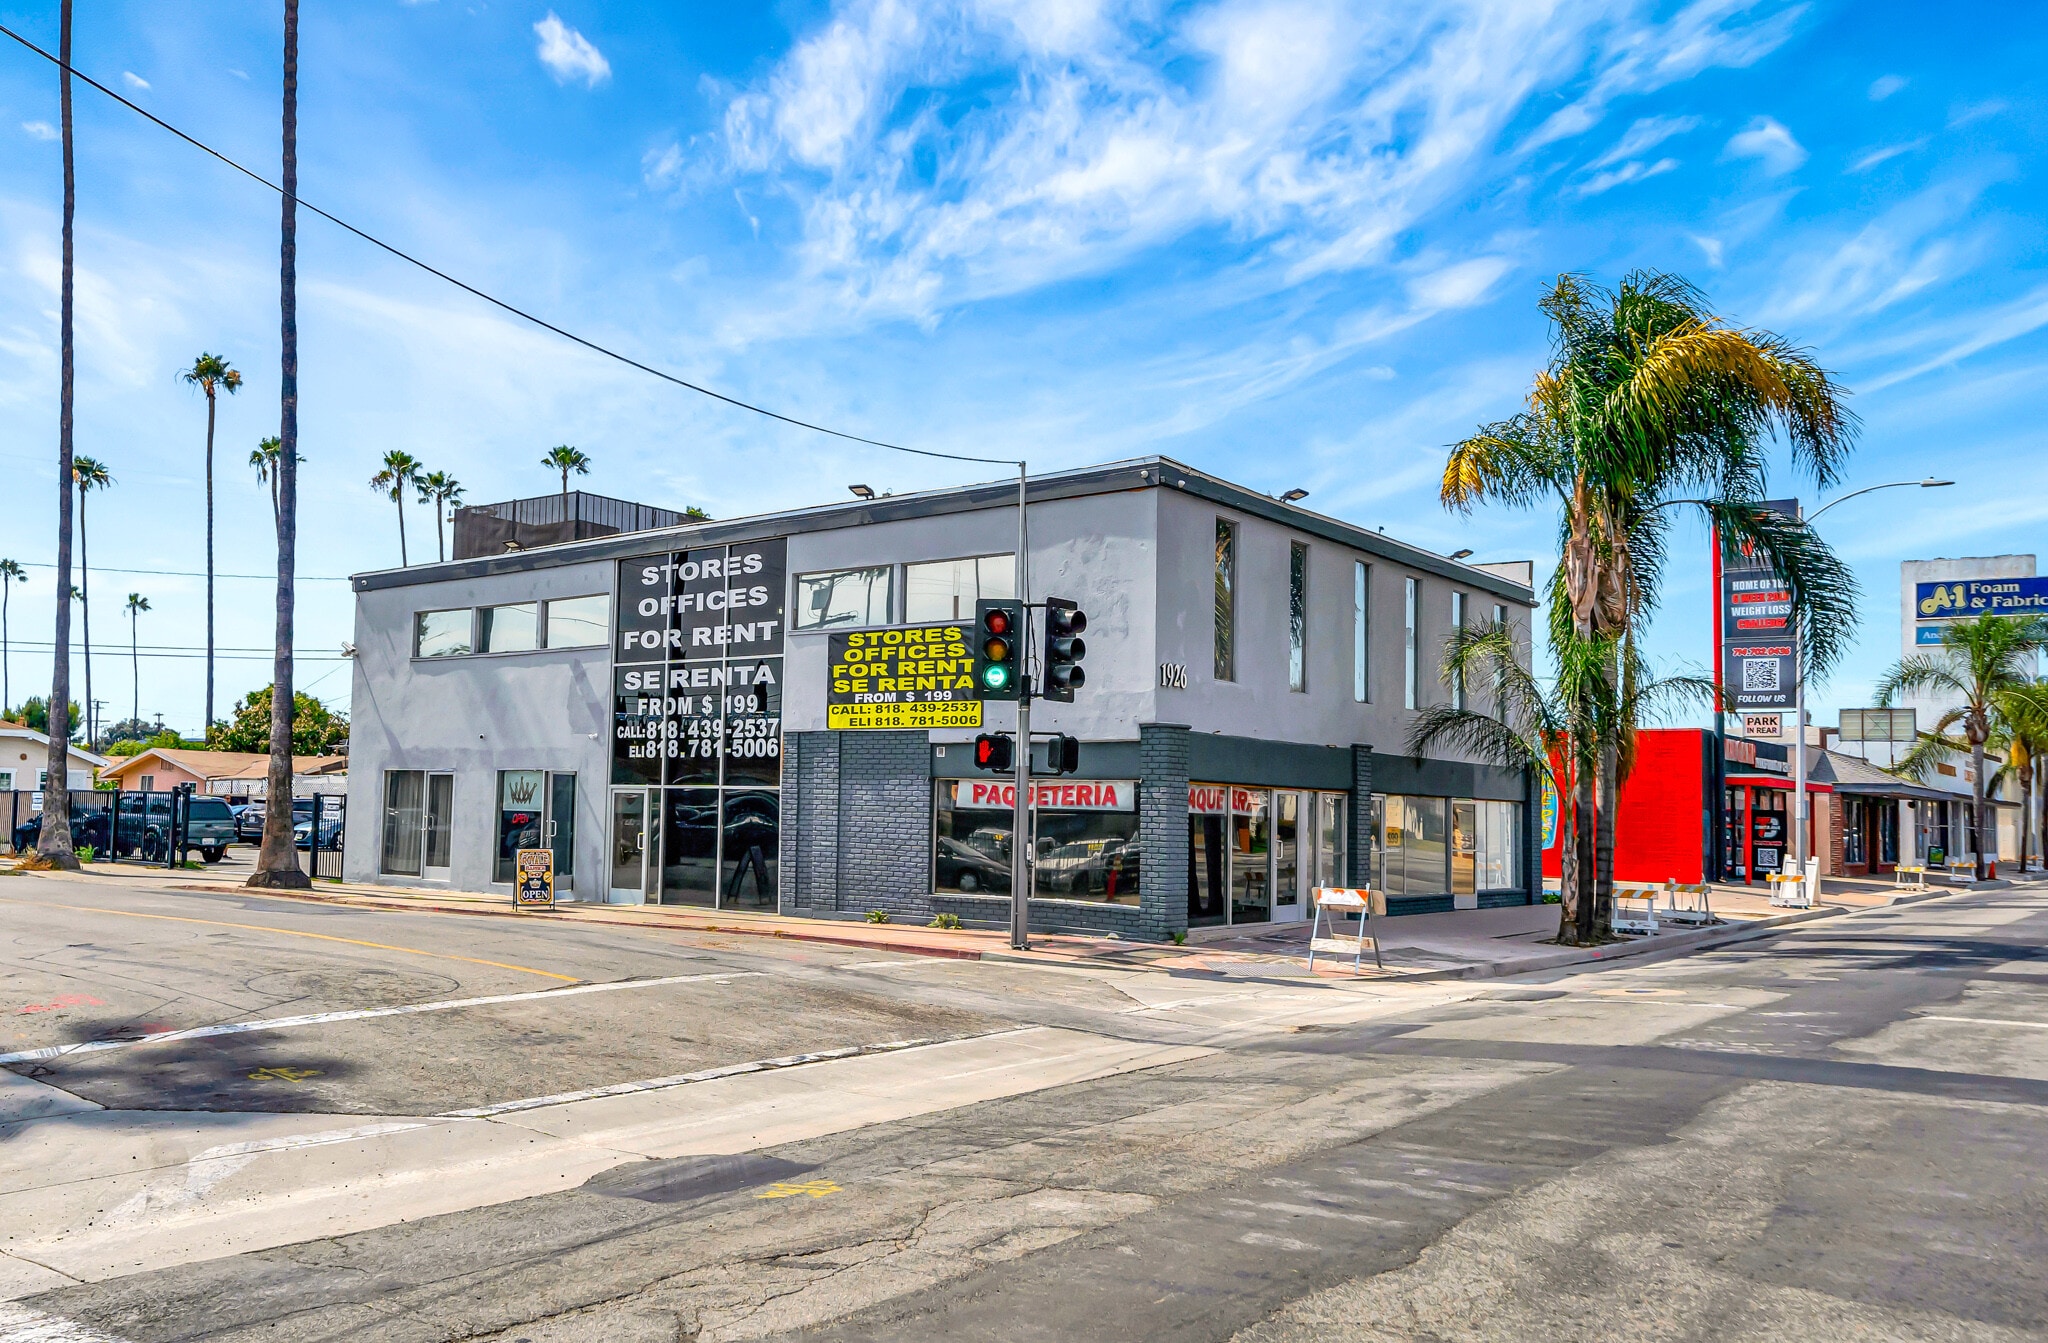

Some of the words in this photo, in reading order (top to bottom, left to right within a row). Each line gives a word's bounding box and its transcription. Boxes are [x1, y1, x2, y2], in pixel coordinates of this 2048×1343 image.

[642, 554, 763, 586] STORES
[1732, 580, 1758, 591] HOME
[1970, 583, 2020, 594] Foam
[638, 586, 768, 616] OFFICES
[1970, 597, 1986, 608] &
[1992, 594, 2048, 607] Fabric
[1731, 606, 1766, 616] WEIGHT
[1768, 605, 1791, 614] LOSS
[624, 629, 682, 650] FOR
[692, 621, 778, 646] RENT
[848, 627, 962, 647] STORES
[844, 643, 965, 662] OFFICES
[833, 663, 888, 678] FOR
[898, 659, 974, 675] RENT
[624, 671, 661, 690] SE
[670, 665, 776, 688] RENTA
[1161, 663, 1187, 689] 1926
[833, 679, 868, 693] SE
[878, 675, 974, 692] RENTA
[855, 693, 896, 703] FROM
[906, 691, 915, 702] $
[924, 691, 952, 700] 199
[1737, 694, 1772, 702] FOLLOW
[1774, 694, 1786, 702] US
[638, 697, 693, 716] FROM
[701, 695, 713, 716] $
[725, 694, 758, 713] 199
[831, 706, 871, 715] CALL:
[910, 703, 978, 713] 439-2537
[849, 718, 870, 726] ELI
[910, 715, 977, 725] 781-5006
[1747, 717, 1778, 725] PARK
[617, 726, 645, 739] CALL:
[523, 890, 548, 898] OPEN
